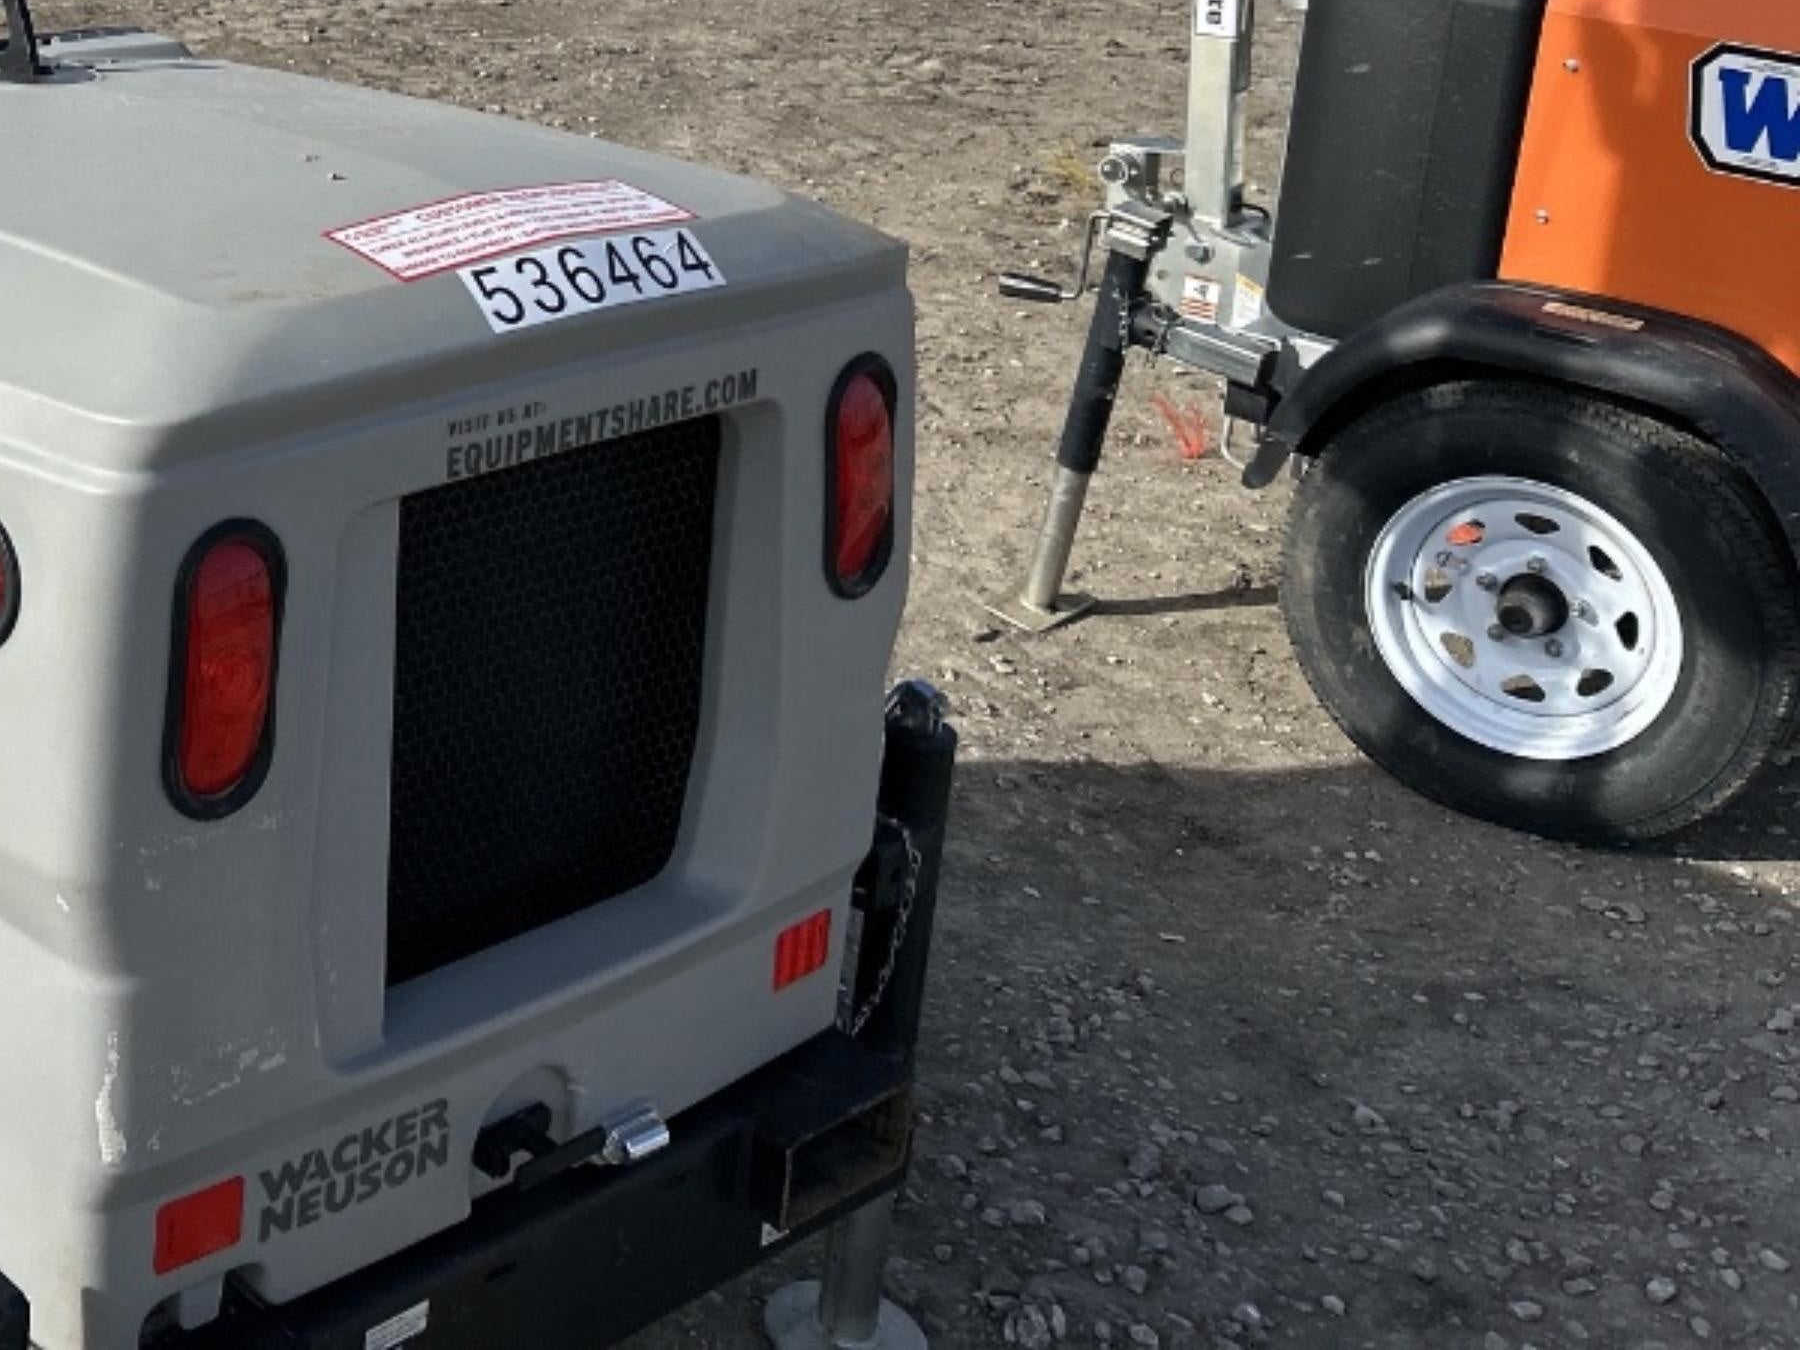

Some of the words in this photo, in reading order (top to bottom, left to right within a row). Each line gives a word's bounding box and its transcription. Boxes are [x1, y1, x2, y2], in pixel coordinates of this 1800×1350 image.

[470, 230, 716, 325] 536464
[446, 368, 758, 480] EQUIPMENTSHARE.COM
[257, 1132, 449, 1243] NEUSON
[258, 1098, 449, 1202] WACKER
